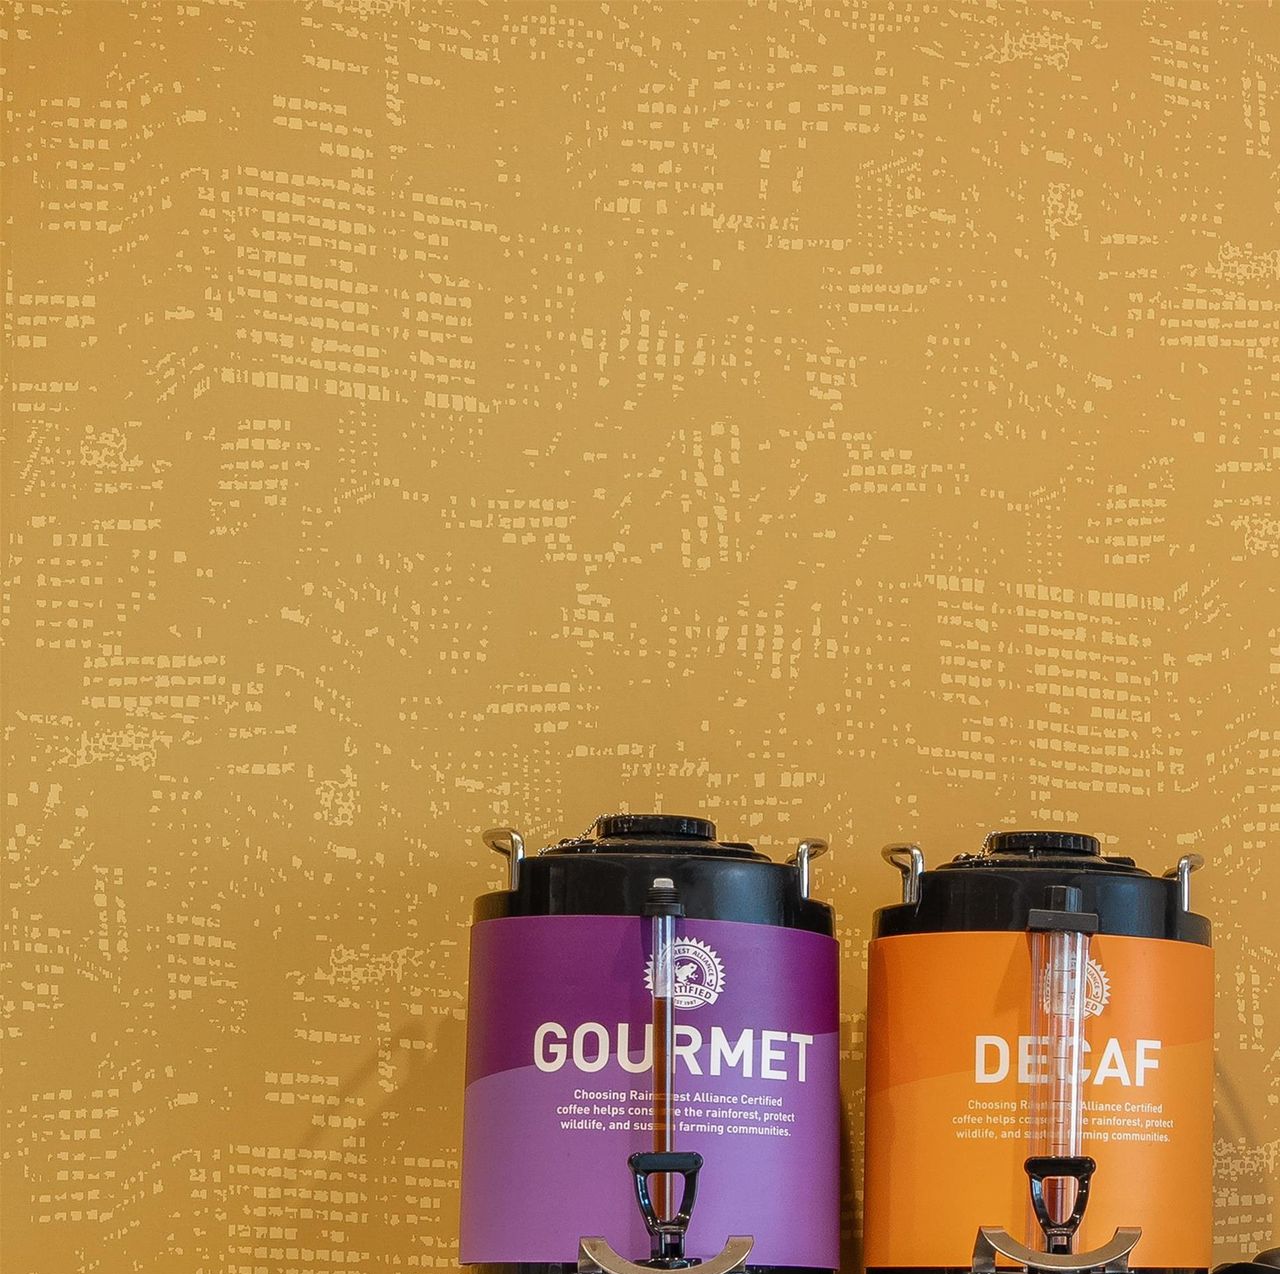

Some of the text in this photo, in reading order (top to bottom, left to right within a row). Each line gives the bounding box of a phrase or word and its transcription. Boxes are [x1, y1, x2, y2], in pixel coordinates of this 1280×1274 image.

[692, 950, 715, 977] ALLIANCE
[533, 1021, 814, 1082] GOURMET
[975, 1035, 1162, 1087] DECAF
[574, 1089, 626, 1102] Choosing
[693, 1092, 738, 1104] Alliance
[740, 1094, 783, 1107] Certified
[968, 1099, 1017, 1111] Choosing
[1081, 1101, 1122, 1112] Alliance
[1124, 1102, 1163, 1114] Certified
[556, 1104, 590, 1115] coffee
[593, 1105, 625, 1117] helps
[684, 1107, 703, 1117] the
[706, 1108, 761, 1121] rainforest,
[763, 1112, 795, 1123] protect
[952, 1114, 983, 1124] coffee
[986, 1115, 1016, 1126] helps
[560, 1119, 606, 1131] wildlife,
[608, 1120, 630, 1130] and
[679, 1121, 724, 1135] farming
[726, 1124, 792, 1137] communities.
[1091, 1117, 1144, 1128] rainforest,
[1145, 1119, 1174, 1129] protect
[956, 1128, 998, 1140] wildlife,
[1000, 1129, 1021, 1139] and
[1111, 1131, 1171, 1143] communities.
